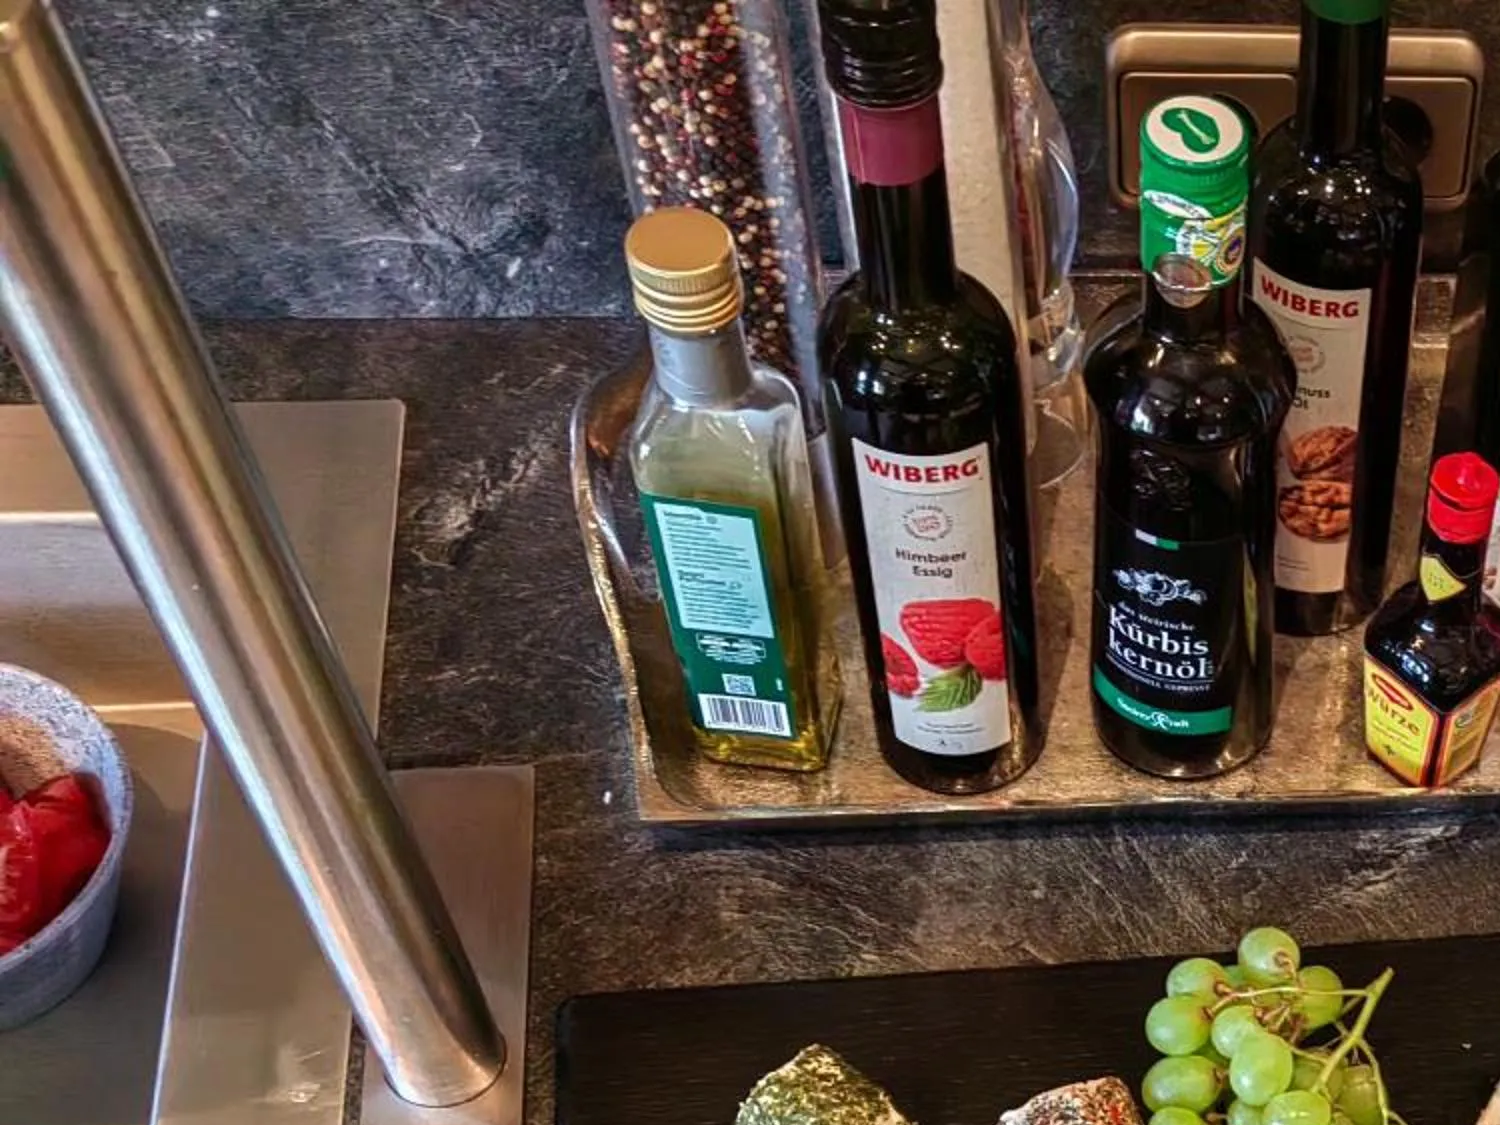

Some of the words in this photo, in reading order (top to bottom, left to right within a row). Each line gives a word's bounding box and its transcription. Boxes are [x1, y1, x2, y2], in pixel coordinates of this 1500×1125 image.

[1261, 275, 1360, 318] WIBERG
[864, 454, 980, 483] WIBERG
[895, 547, 967, 564] Himbeer
[912, 565, 953, 579] Essig
[1110, 604, 1209, 655] Kürbis
